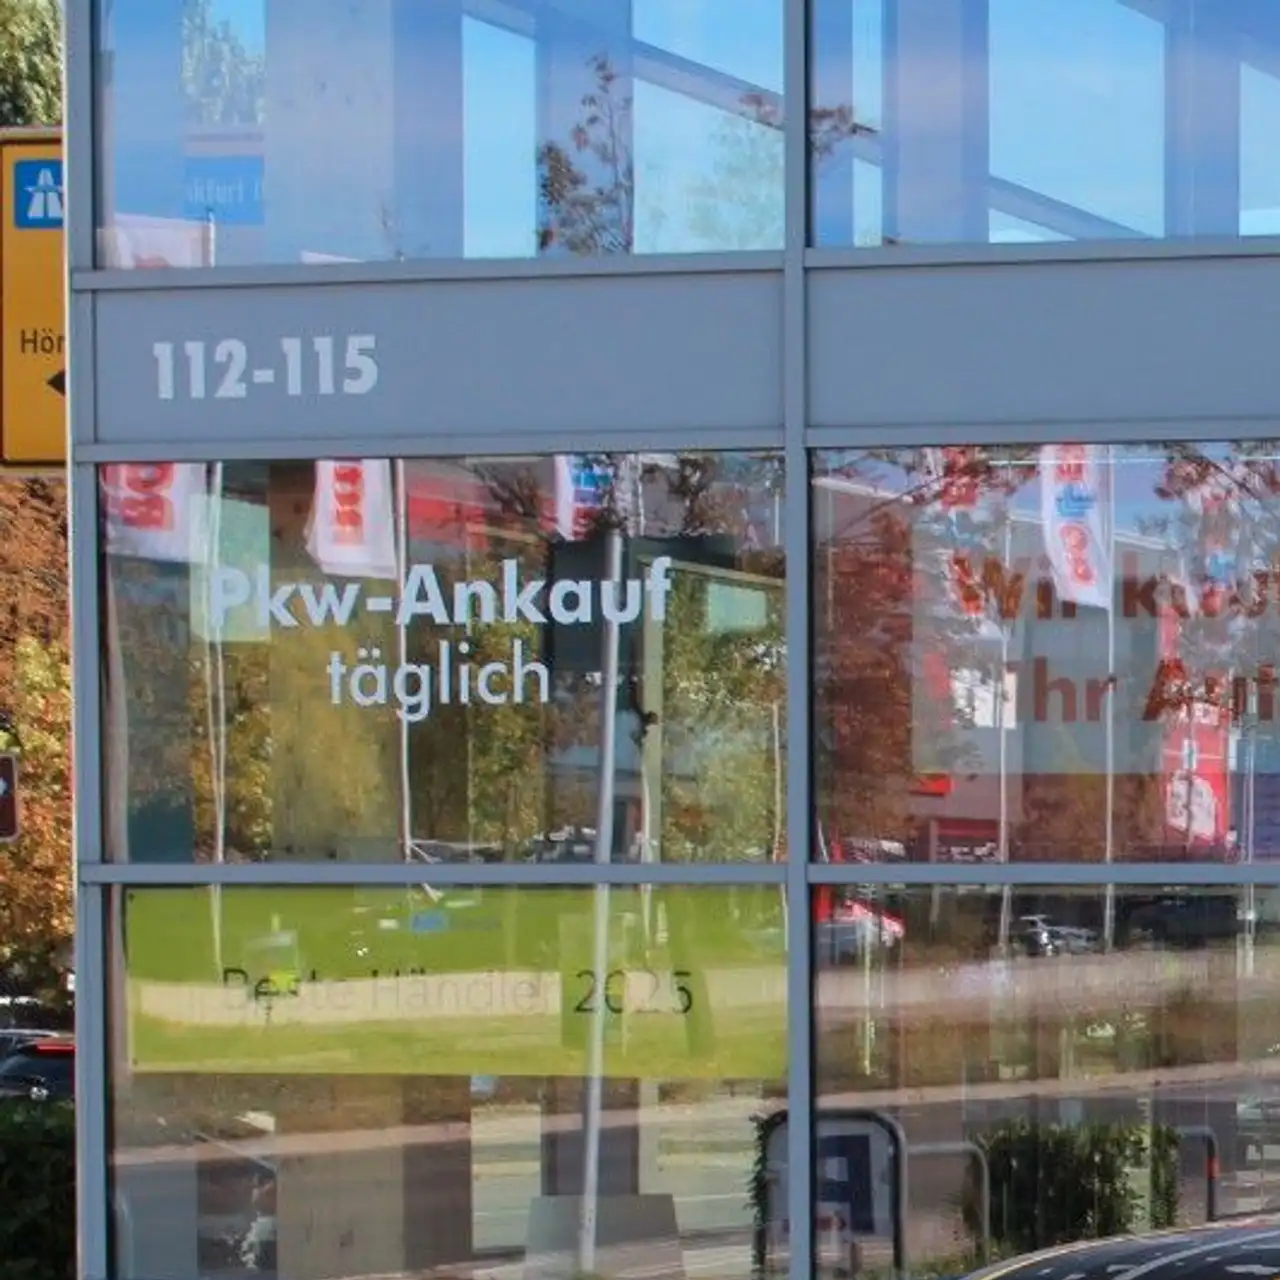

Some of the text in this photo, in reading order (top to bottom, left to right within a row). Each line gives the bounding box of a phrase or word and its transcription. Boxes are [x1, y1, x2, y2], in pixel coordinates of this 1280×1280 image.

[153, 334, 378, 400] 112-115
[208, 555, 671, 626] Pkw-Ankauf
[327, 639, 550, 724] täglich
[573, 968, 693, 1014] 2025
